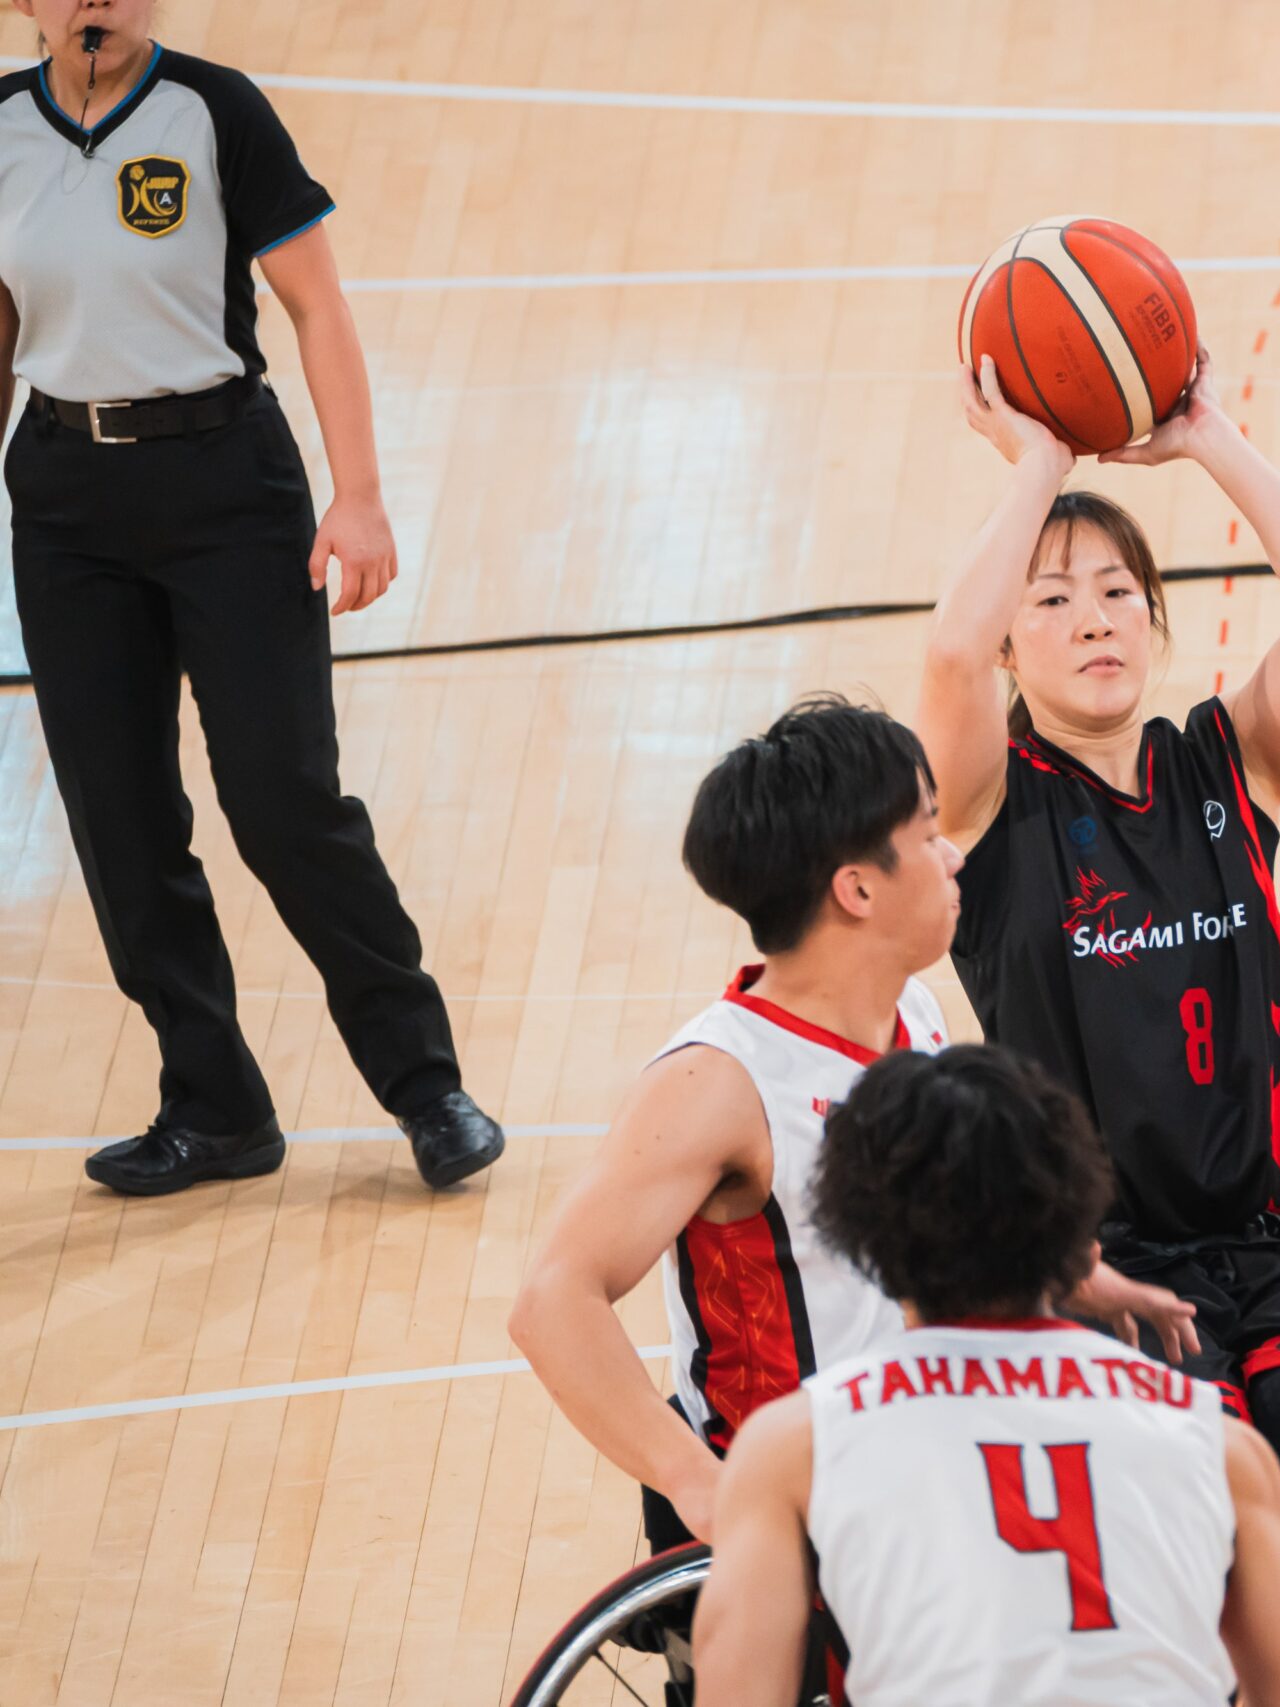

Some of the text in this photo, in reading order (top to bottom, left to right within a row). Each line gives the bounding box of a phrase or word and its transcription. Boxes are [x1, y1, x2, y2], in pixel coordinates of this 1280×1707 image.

[160, 192, 172, 204] A
[1143, 292, 1176, 343] FIBA
[1073, 903, 1247, 957] SAGAMI FORE
[1179, 988, 1215, 1085] 8
[975, 1440, 1120, 1633] 4
